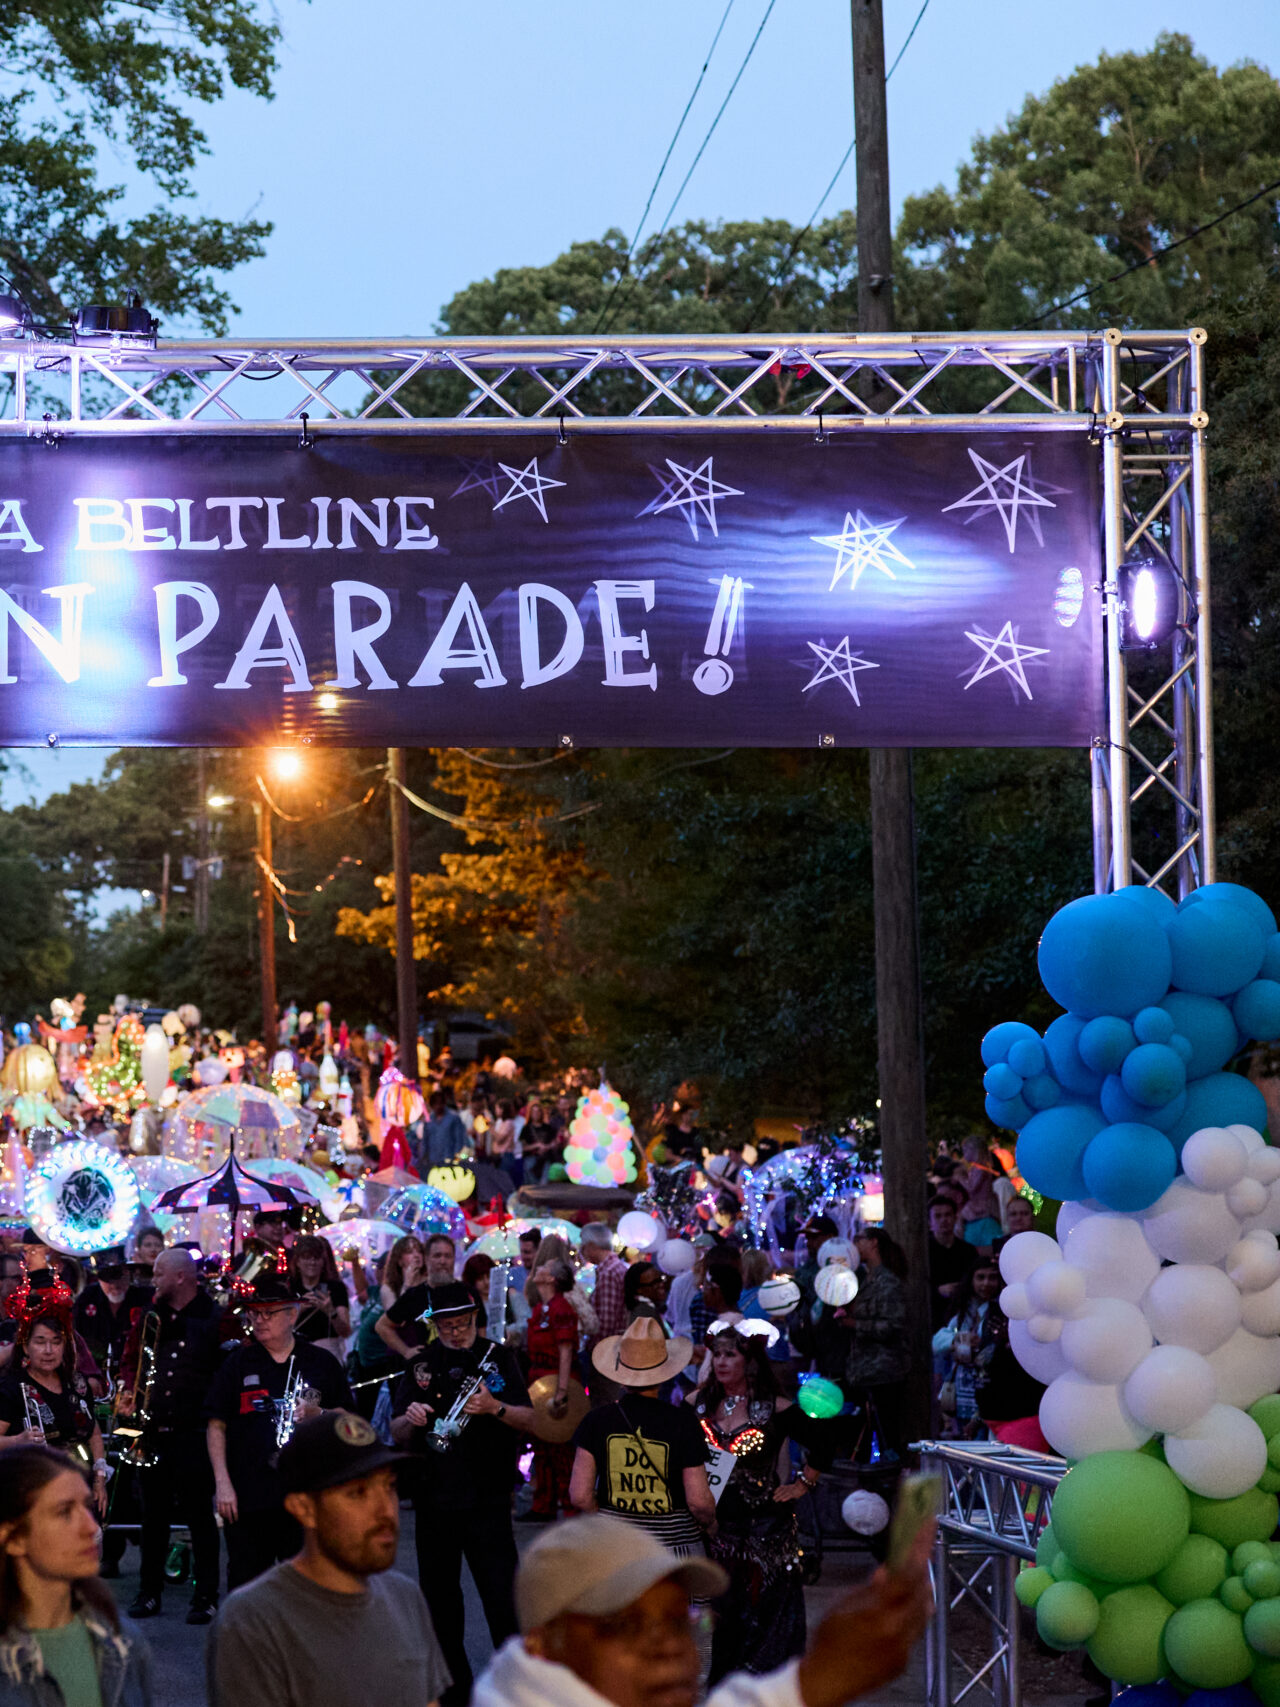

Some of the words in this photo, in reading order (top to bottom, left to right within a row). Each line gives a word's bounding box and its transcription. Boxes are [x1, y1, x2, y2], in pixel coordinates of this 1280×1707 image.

[73, 496, 439, 551] BELTLINE
[624, 1447, 652, 1470] DO
[619, 1472, 659, 1494] NOT
[616, 1497, 665, 1514] PASS
